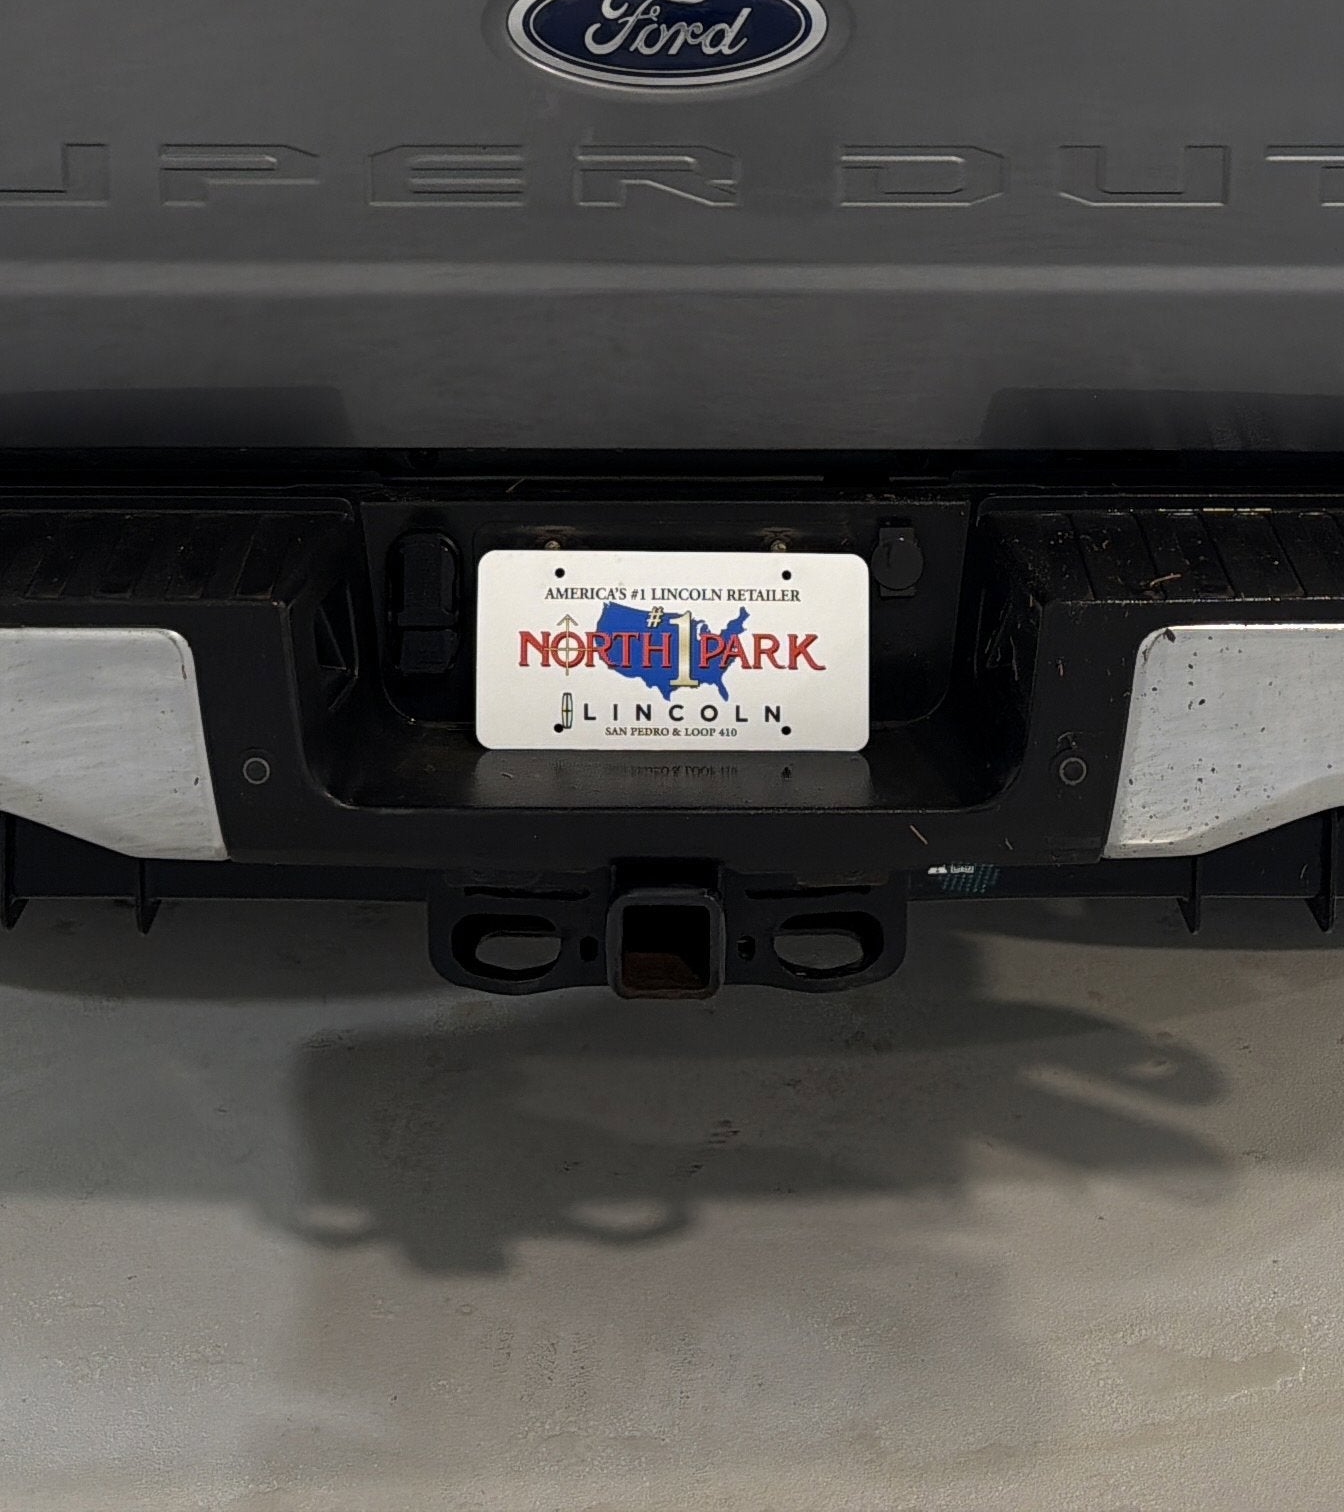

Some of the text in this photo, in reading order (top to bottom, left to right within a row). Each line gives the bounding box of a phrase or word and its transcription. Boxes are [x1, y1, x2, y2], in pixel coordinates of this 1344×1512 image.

[545, 587, 802, 602] AMERICA'S #1 LINCOLN RETAILER
[518, 630, 827, 671] NORTH PARK
[583, 702, 782, 723] LINCOLN
[605, 726, 738, 737] SAN PEDRO & LOOP 410
